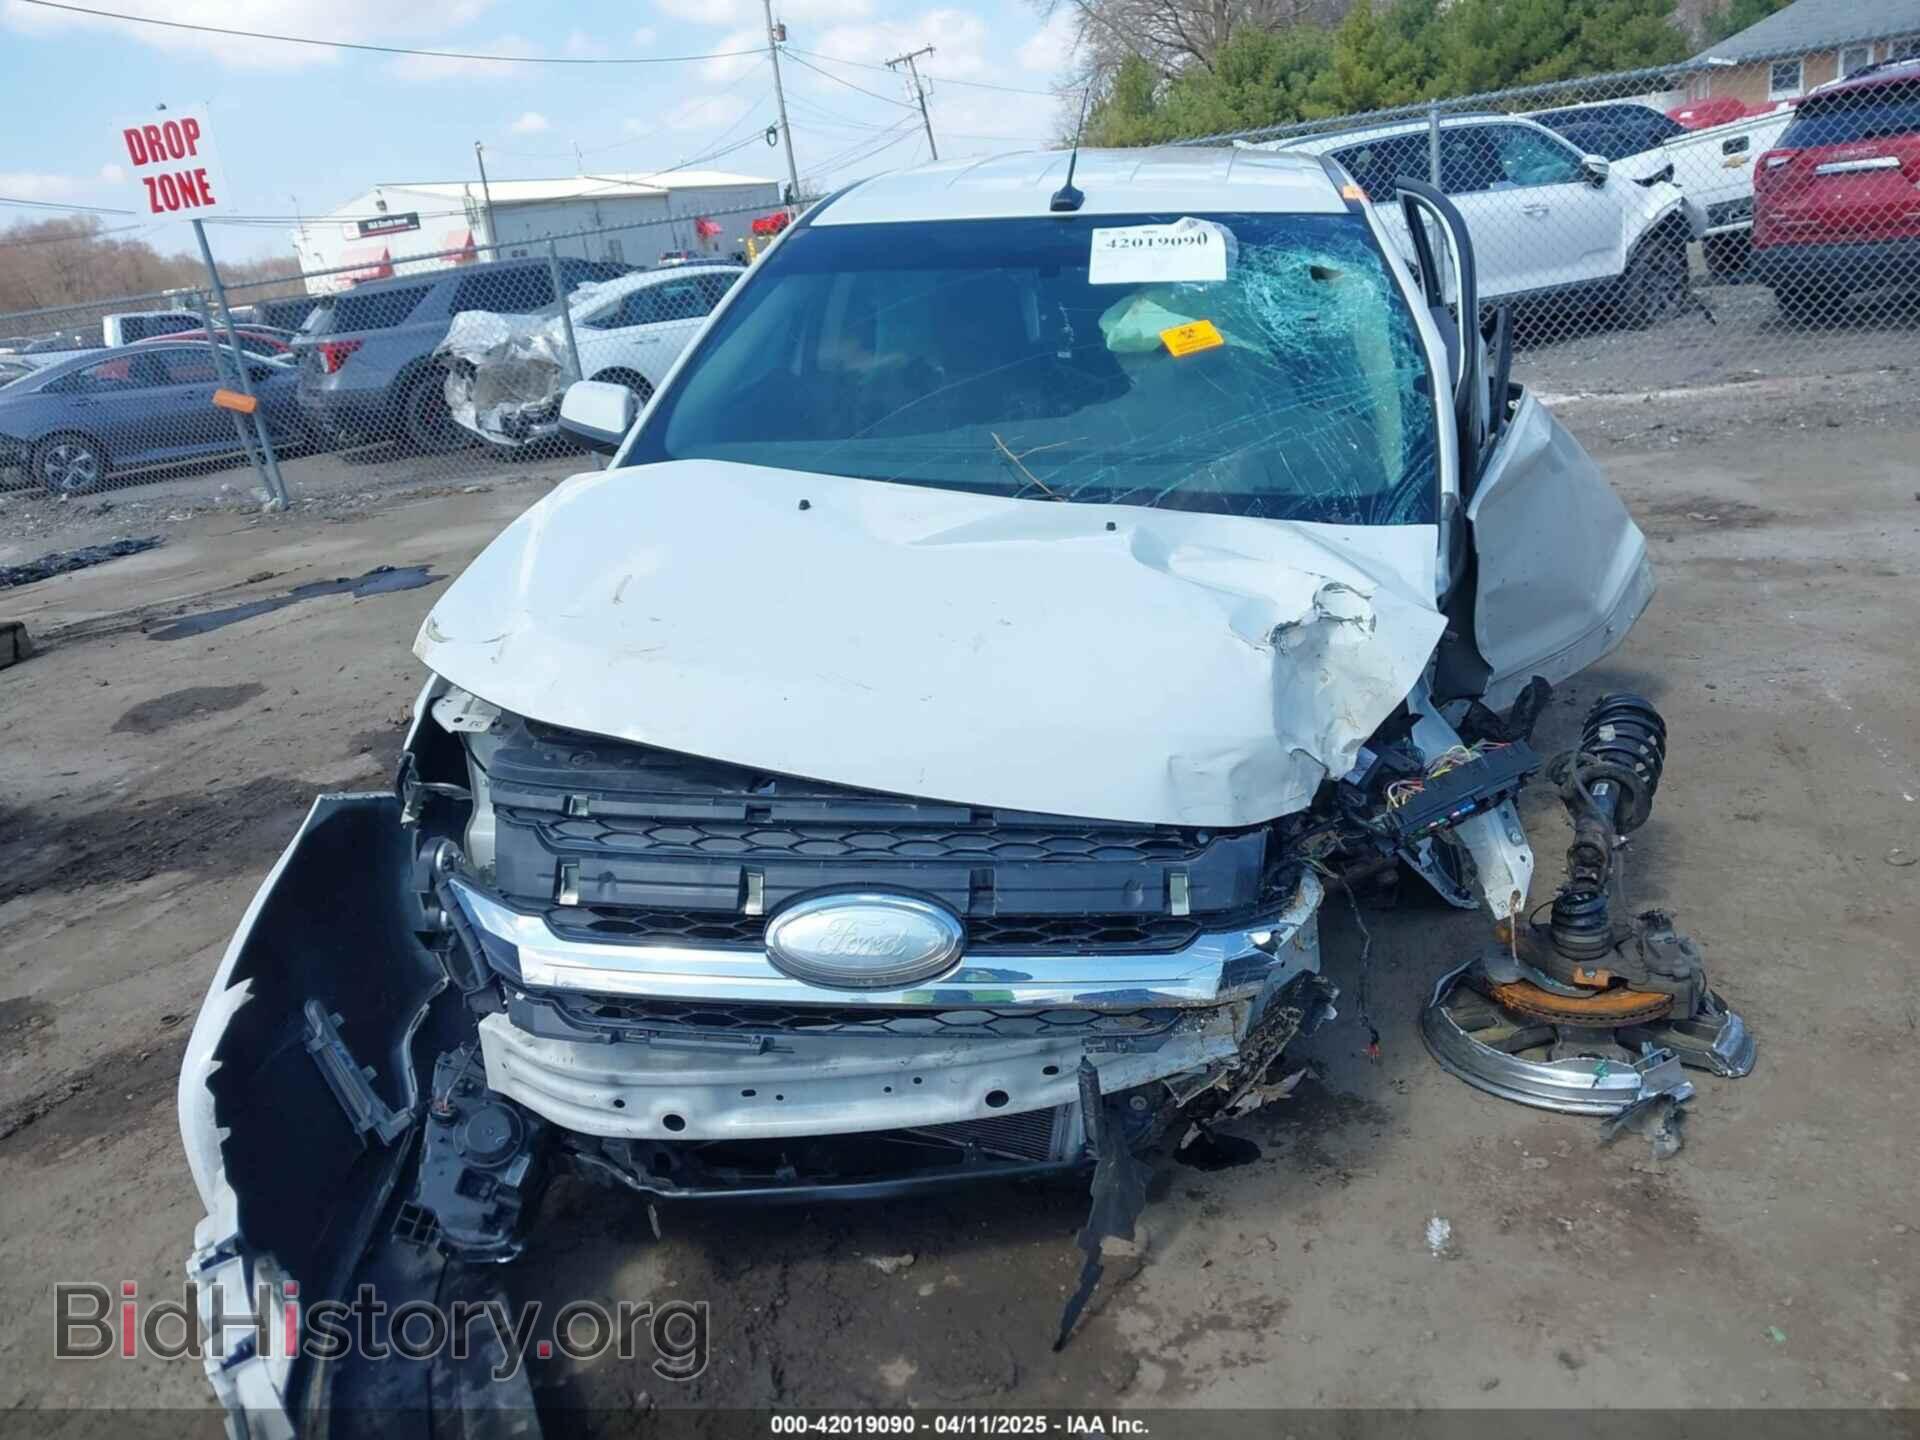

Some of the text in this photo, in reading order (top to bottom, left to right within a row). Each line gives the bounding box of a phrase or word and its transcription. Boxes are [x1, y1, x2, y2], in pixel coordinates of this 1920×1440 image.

[123, 117, 200, 166] DROP
[142, 168, 216, 214] ZONE
[1106, 231, 1208, 249] 42019090
[816, 918, 912, 957] Ford
